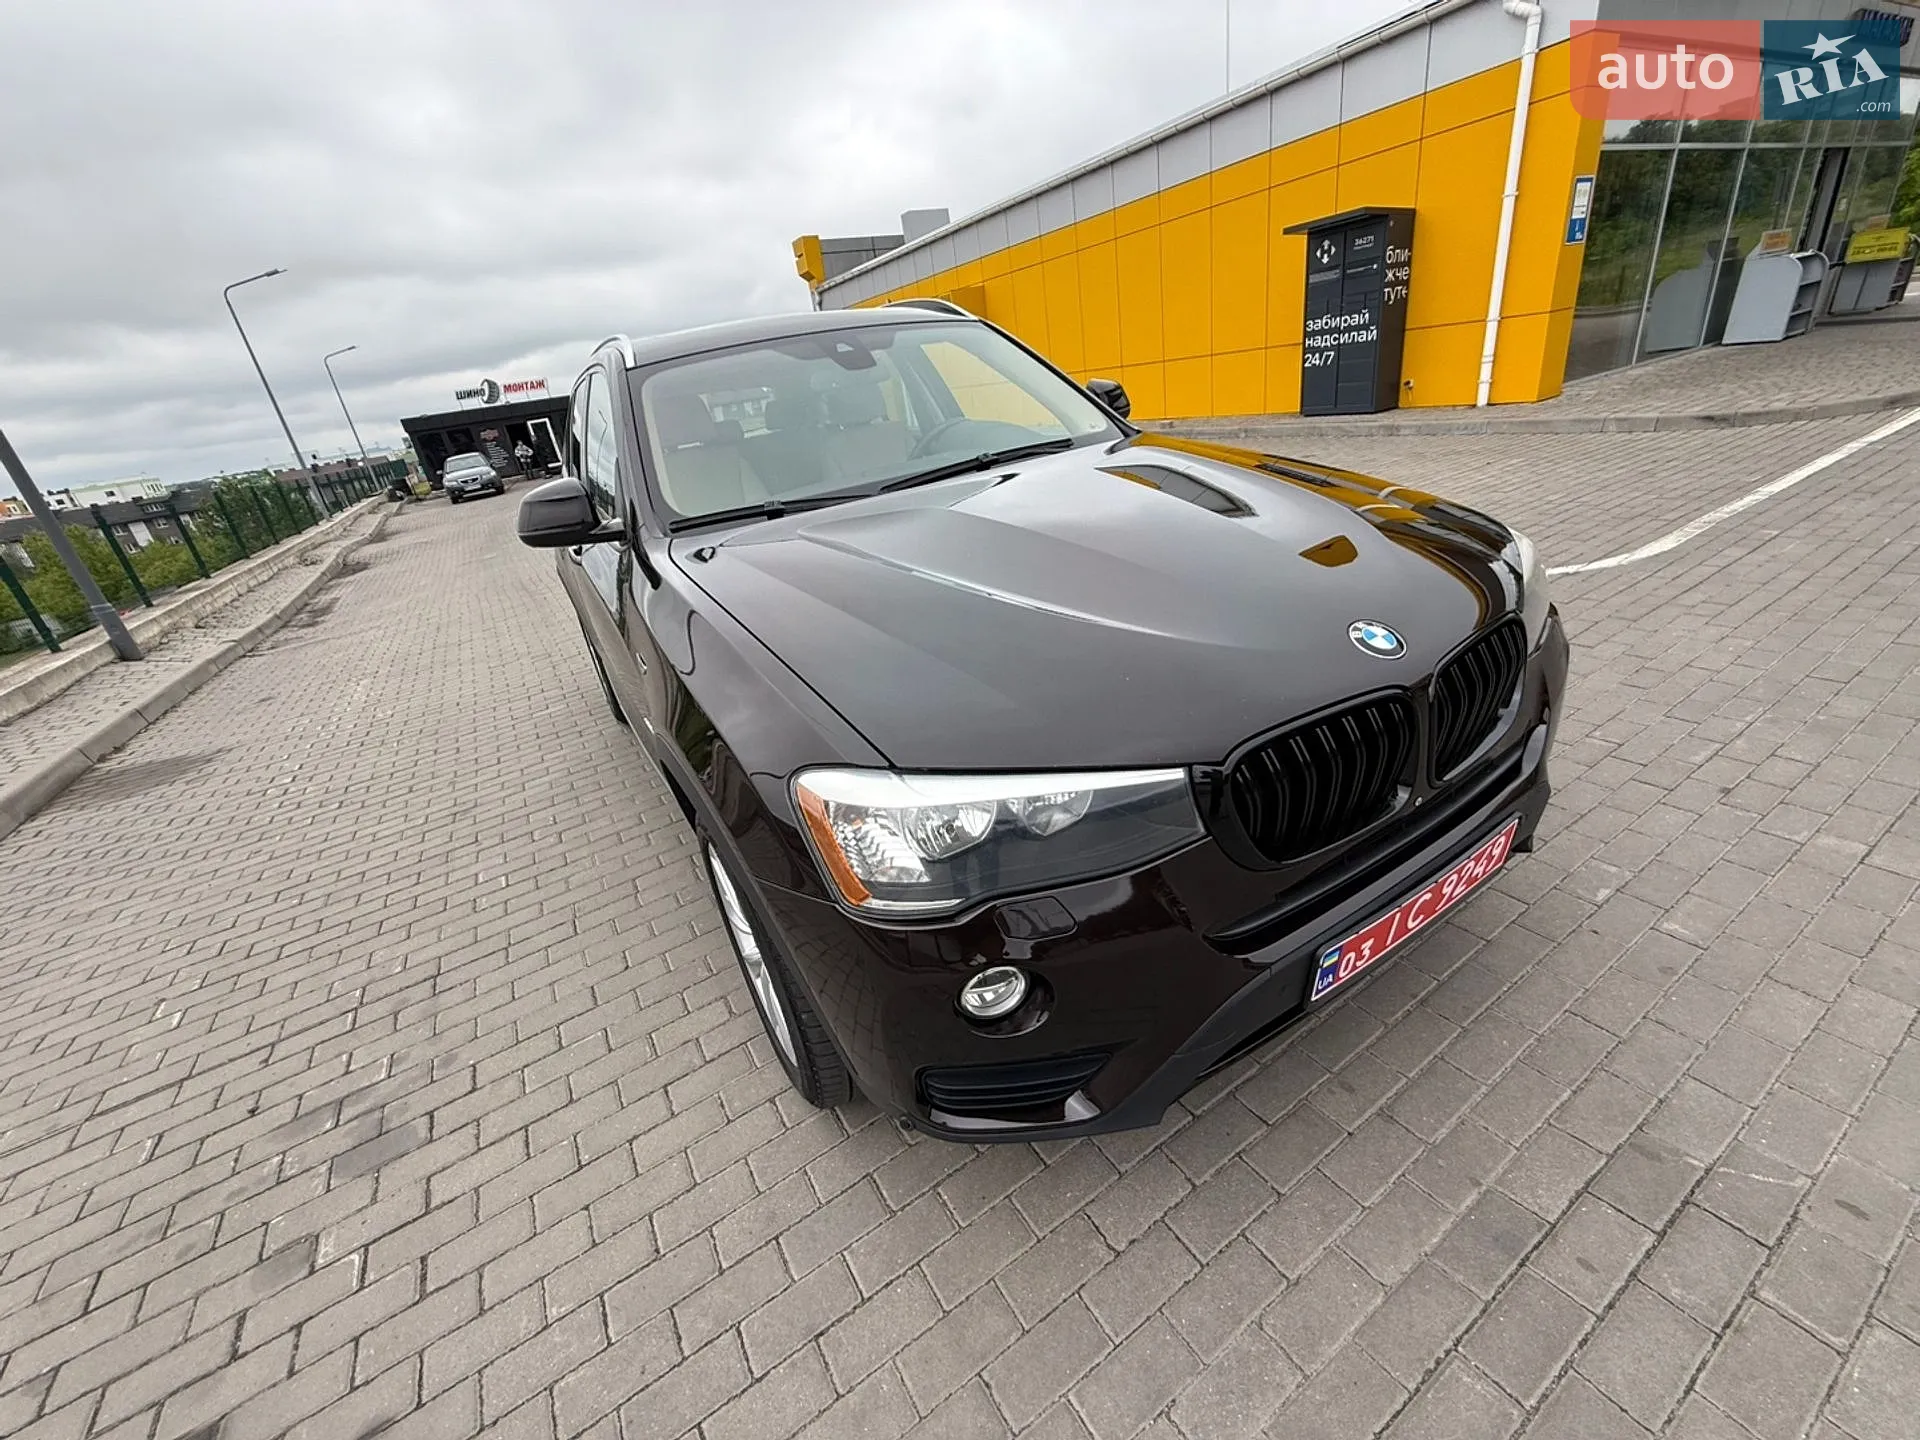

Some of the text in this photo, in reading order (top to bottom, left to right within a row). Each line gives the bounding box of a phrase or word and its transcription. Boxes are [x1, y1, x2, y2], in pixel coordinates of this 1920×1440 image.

[1385, 245, 1412, 264] бли-
[1384, 266, 1410, 283] жче
[1305, 309, 1369, 331] забирай
[1305, 326, 1378, 348] надсилай
[1303, 351, 1335, 368] 24/7
[456, 379, 545, 400] ШИНО МОНТАЖ
[1337, 937, 1375, 979] 03
[1434, 835, 1507, 911] 9249
[1317, 974, 1334, 990] UA
